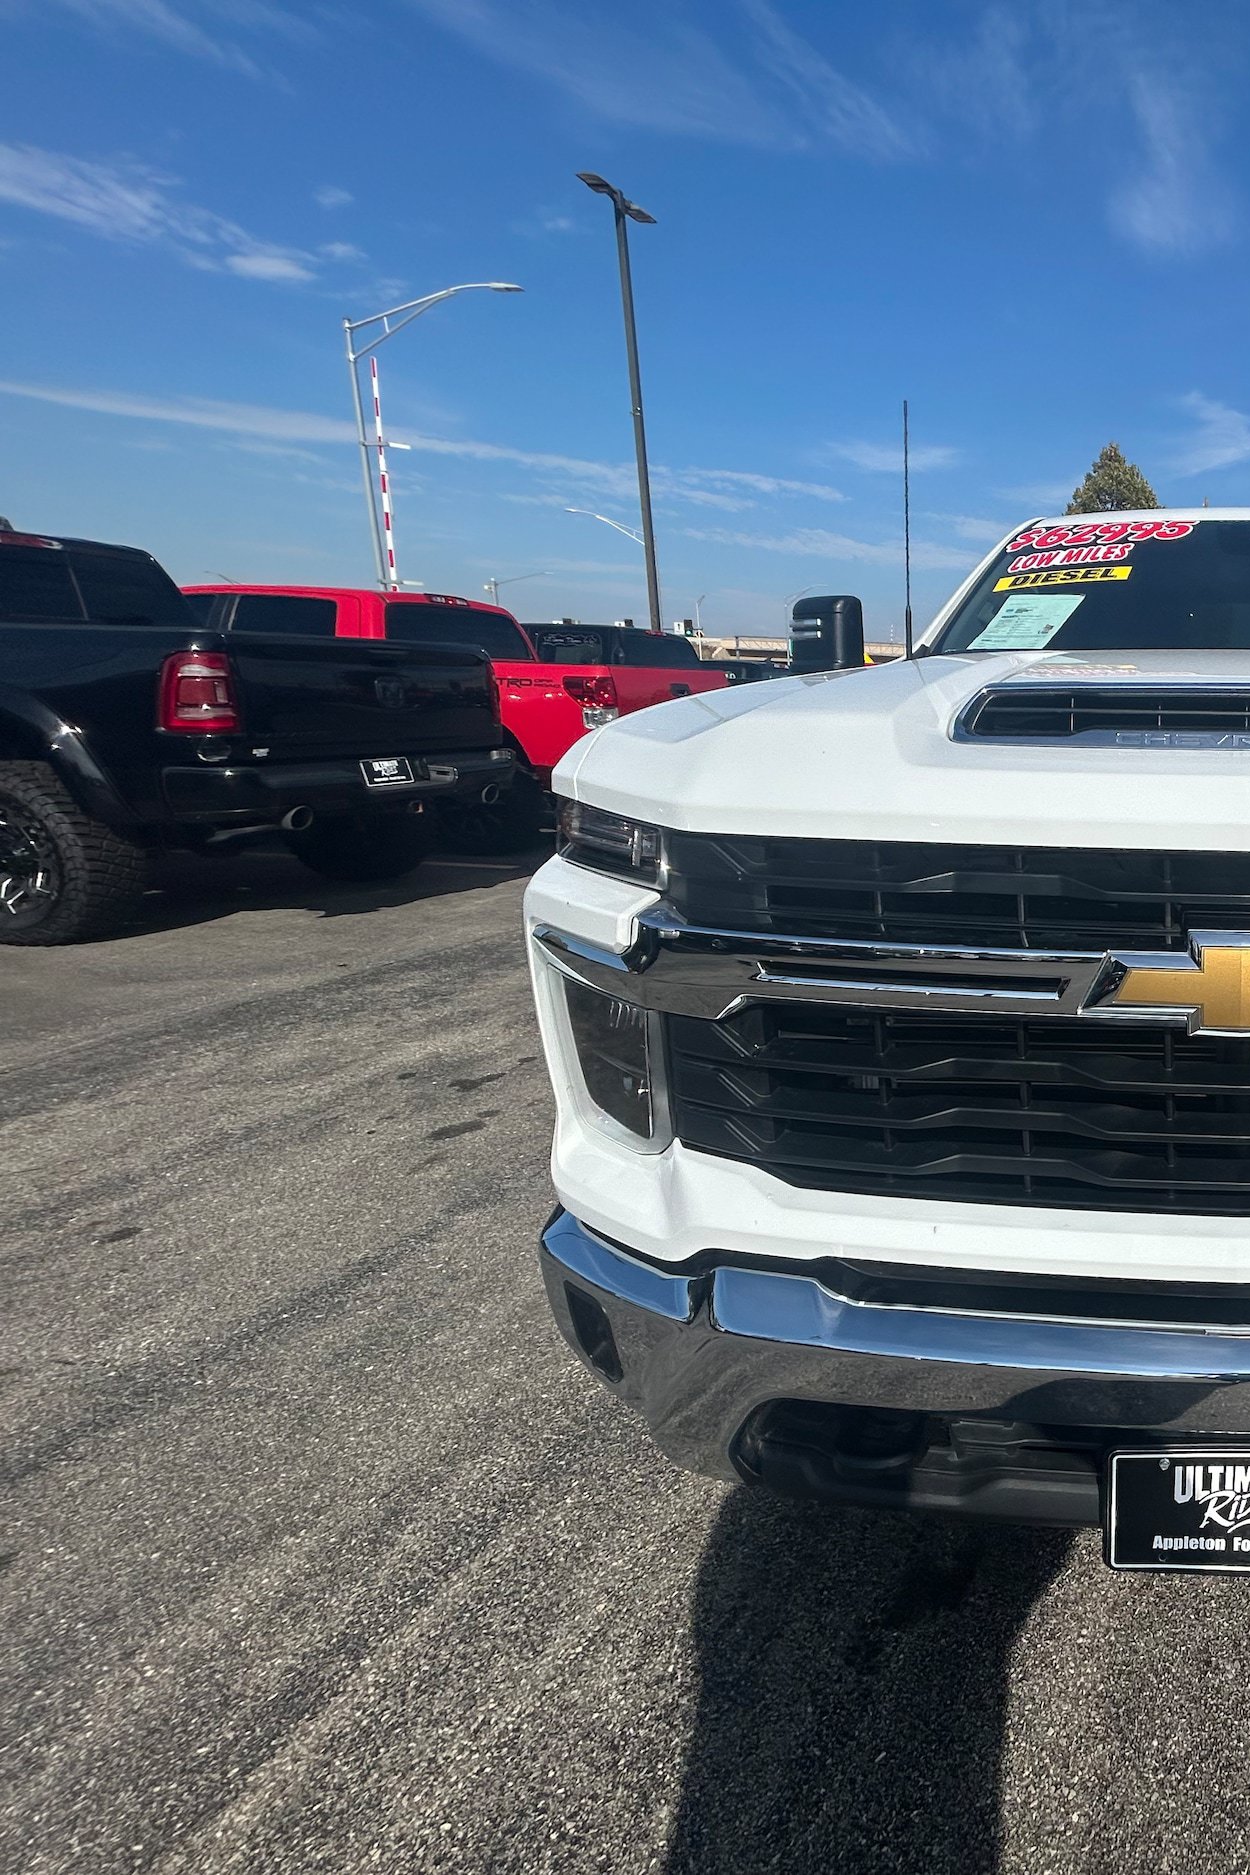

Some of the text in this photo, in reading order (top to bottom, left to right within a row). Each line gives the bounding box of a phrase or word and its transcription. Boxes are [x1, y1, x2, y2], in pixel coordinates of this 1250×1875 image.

[1006, 520, 1200, 552] $62995
[1007, 543, 1135, 573] LOW MILES
[1007, 567, 1117, 588] DIESEL
[1152, 1535, 1226, 1551] Appleton
